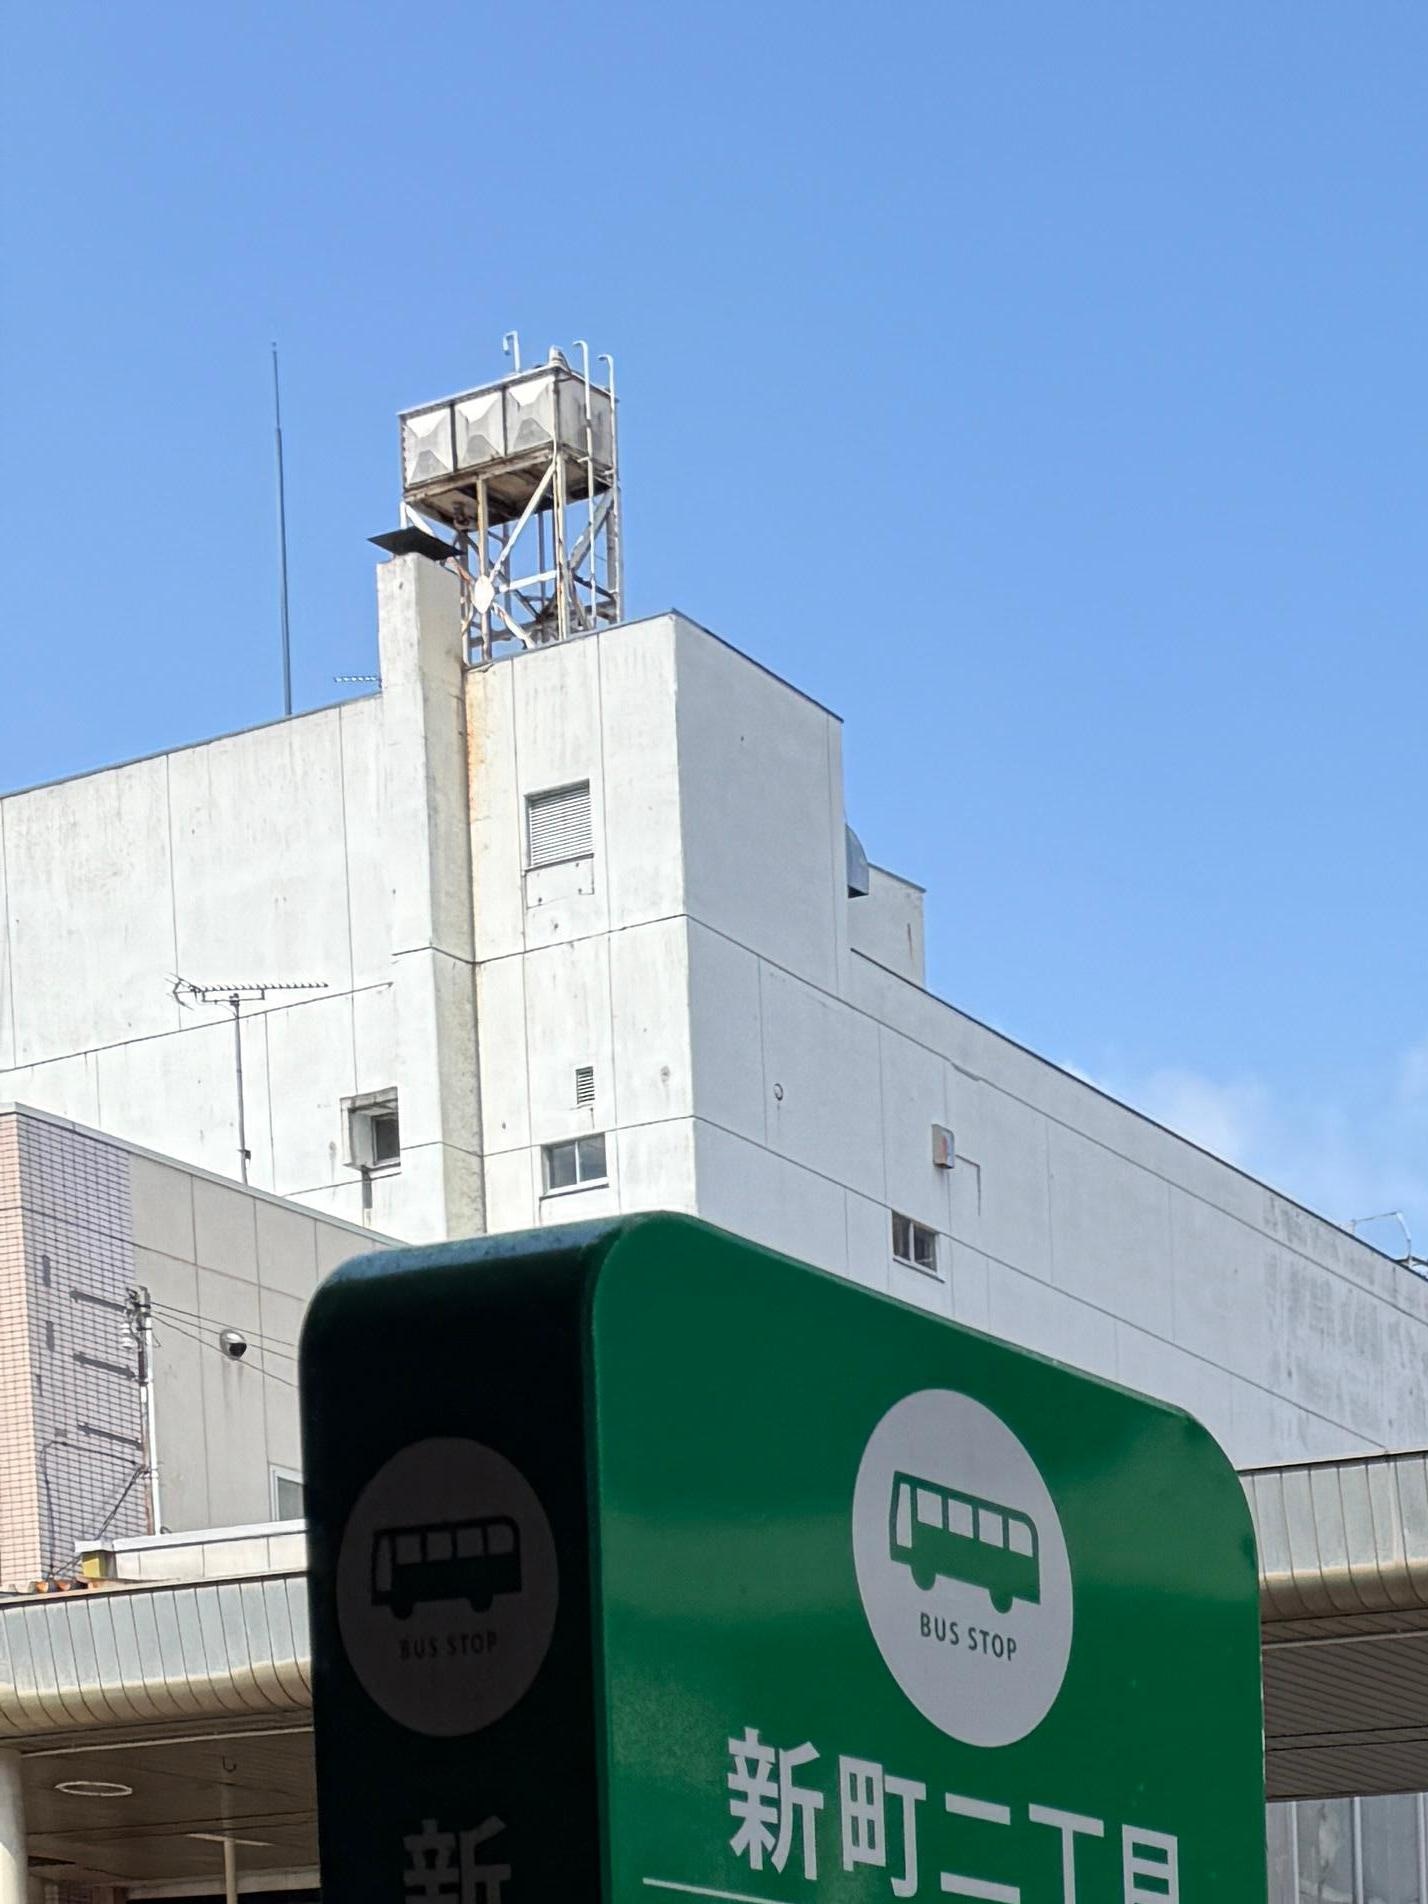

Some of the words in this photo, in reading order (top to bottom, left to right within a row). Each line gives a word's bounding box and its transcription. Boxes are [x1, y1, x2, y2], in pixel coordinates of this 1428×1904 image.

[398, 1635, 438, 1660] BUS
[446, 1631, 497, 1657] STOP
[918, 1612, 959, 1651] BUS
[966, 1623, 1019, 1664] STOP
